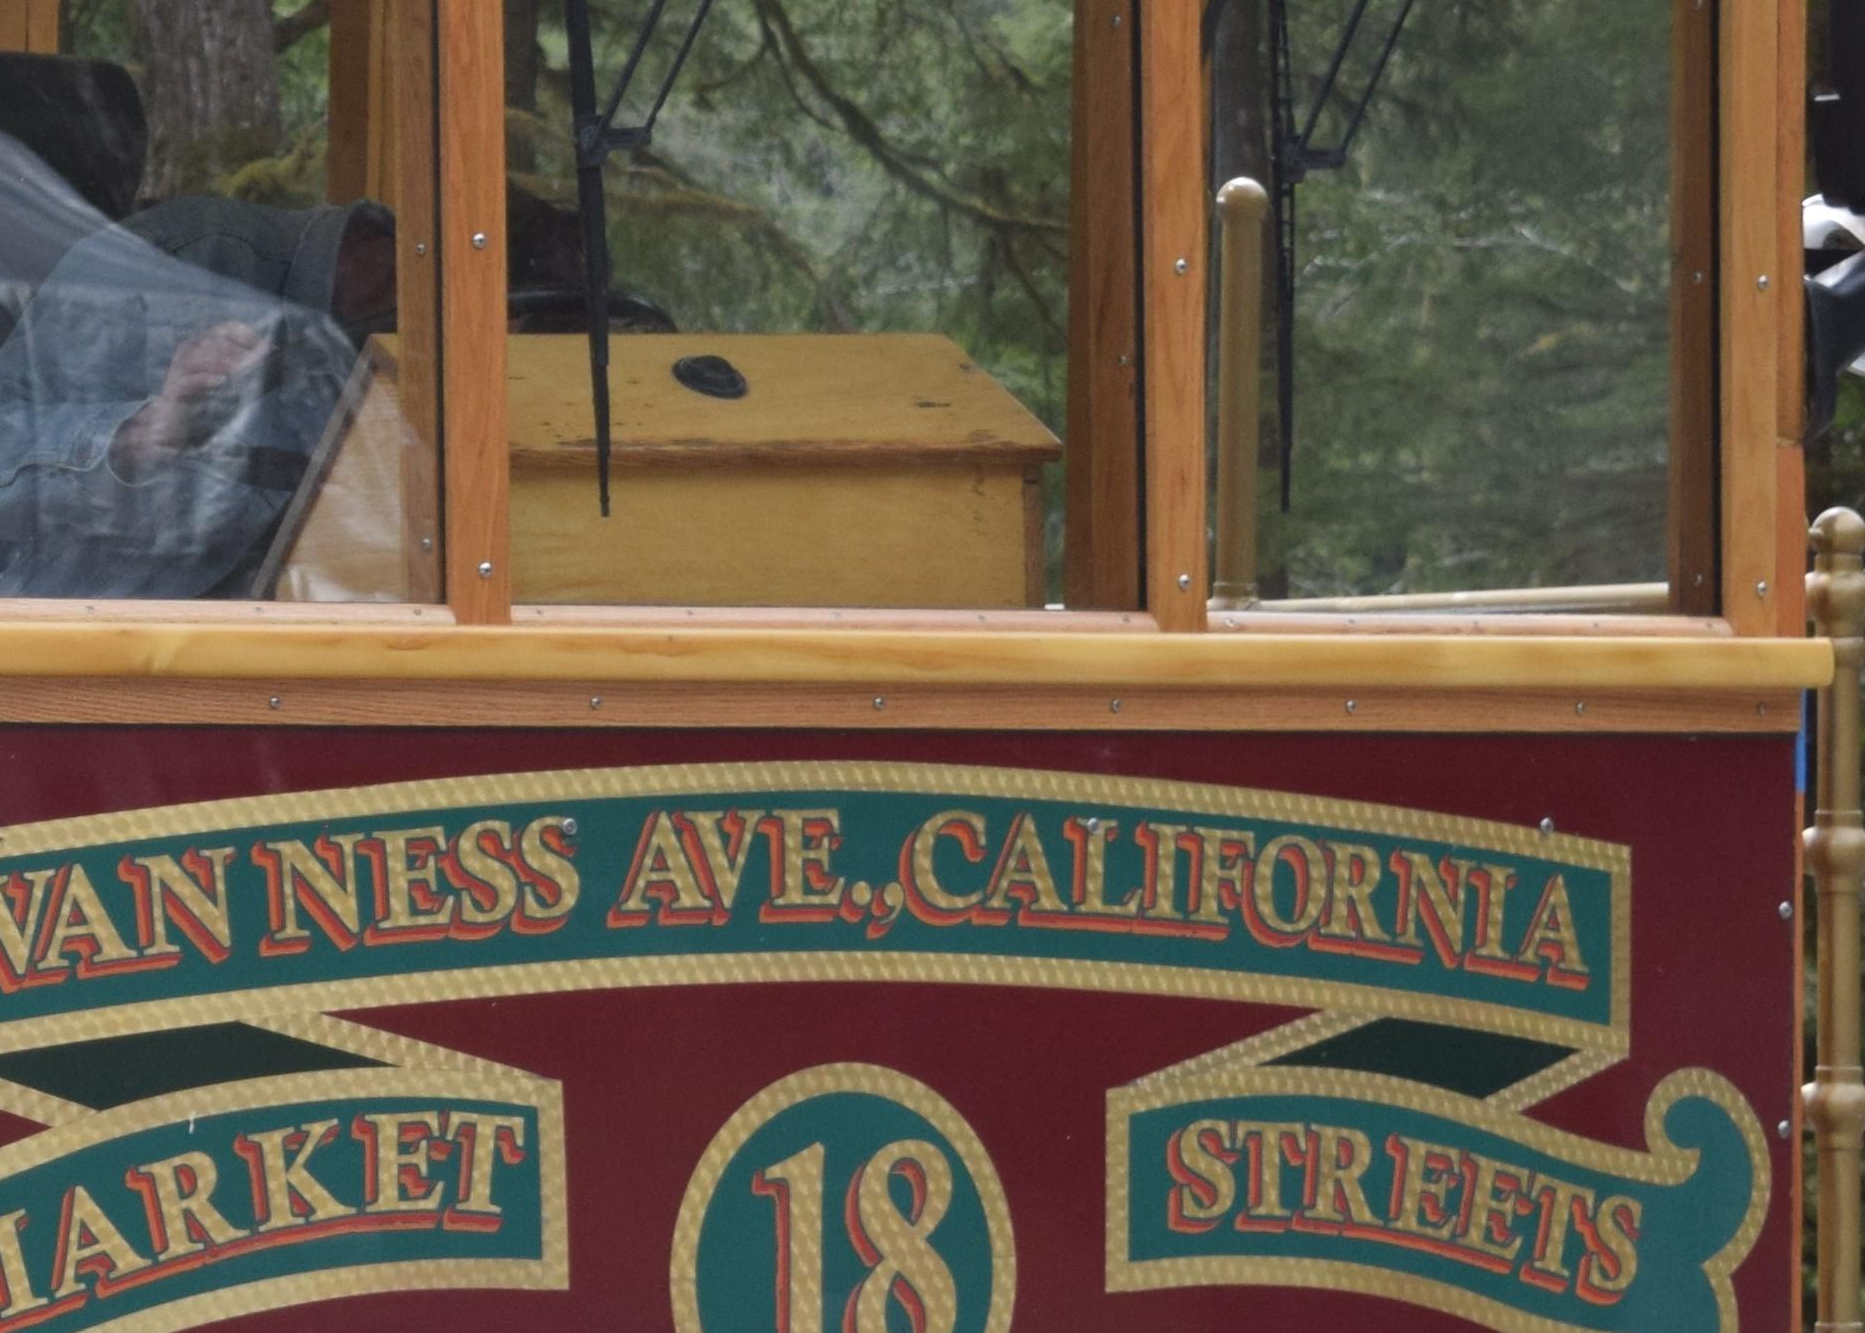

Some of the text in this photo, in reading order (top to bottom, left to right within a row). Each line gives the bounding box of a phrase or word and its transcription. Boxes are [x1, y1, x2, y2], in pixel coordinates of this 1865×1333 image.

[250, 815, 581, 959] NESS
[899, 808, 1592, 991] CALIFORNIA
[1168, 1118, 1644, 1306] STREETS
